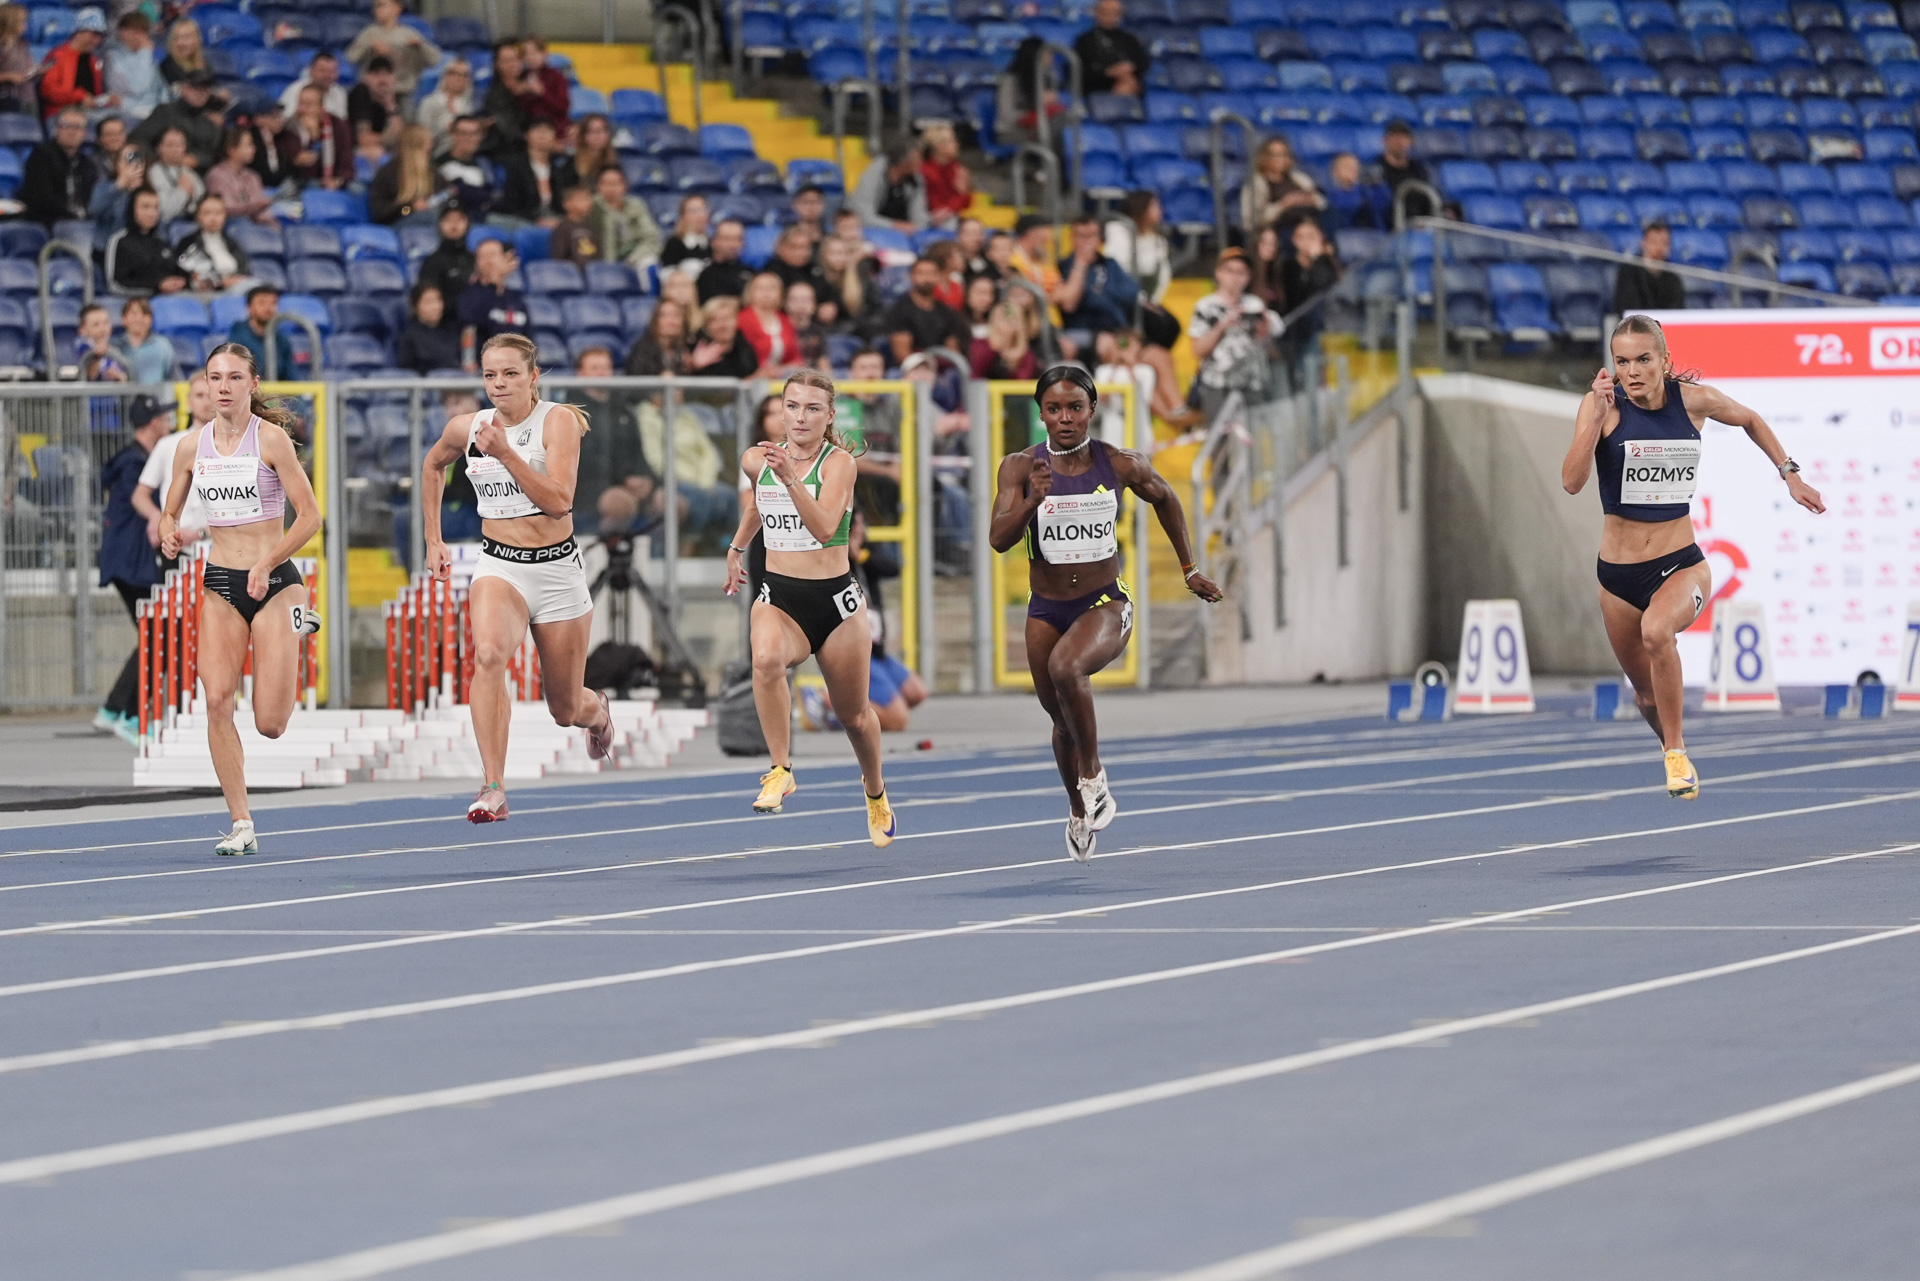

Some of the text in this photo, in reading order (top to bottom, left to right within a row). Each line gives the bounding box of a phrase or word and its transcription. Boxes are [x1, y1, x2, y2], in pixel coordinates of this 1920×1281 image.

[1795, 333, 1853, 365] 72.
[1626, 466, 1695, 482] ROZMYS
[198, 485, 258, 501] NOWAK
[475, 481, 524, 497] WOJTUN
[1043, 521, 1111, 541] ALONSO
[494, 542, 572, 560] NIKE PRO
[842, 591, 857, 613] 6
[293, 608, 302, 630] 8
[1467, 626, 1481, 684] 9
[1495, 626, 1517, 684] 9
[1735, 624, 1762, 682] 8
